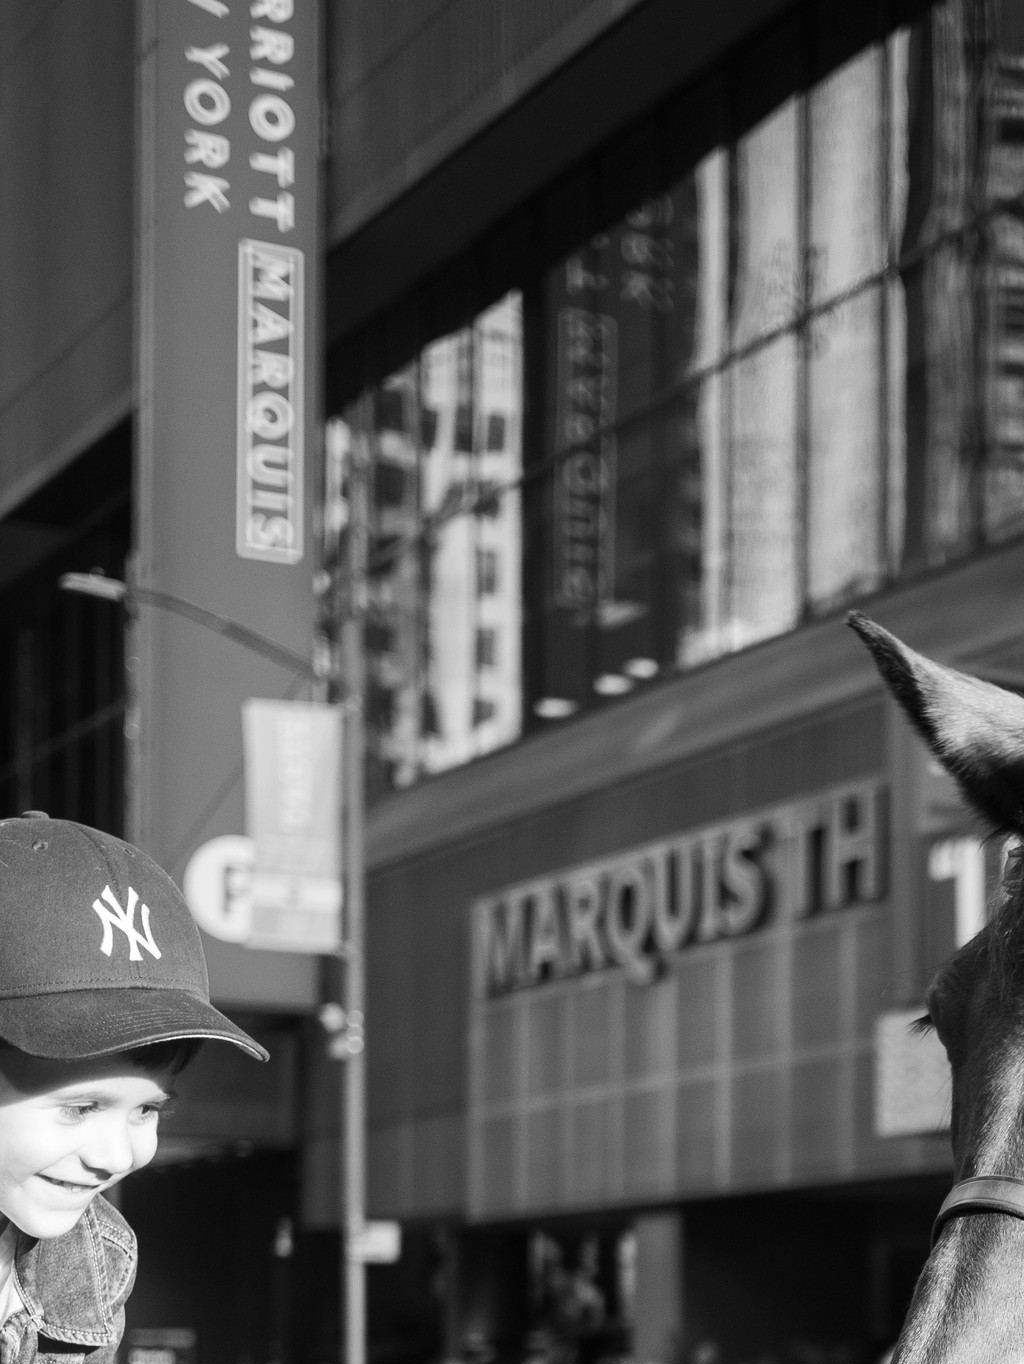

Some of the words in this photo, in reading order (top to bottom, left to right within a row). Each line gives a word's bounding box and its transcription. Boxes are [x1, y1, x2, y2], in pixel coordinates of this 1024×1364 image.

[184, 42, 232, 214] YORK
[247, 249, 296, 552] MARQUIS
[92, 885, 162, 961] NY
[472, 820, 776, 998] MARQUIS
